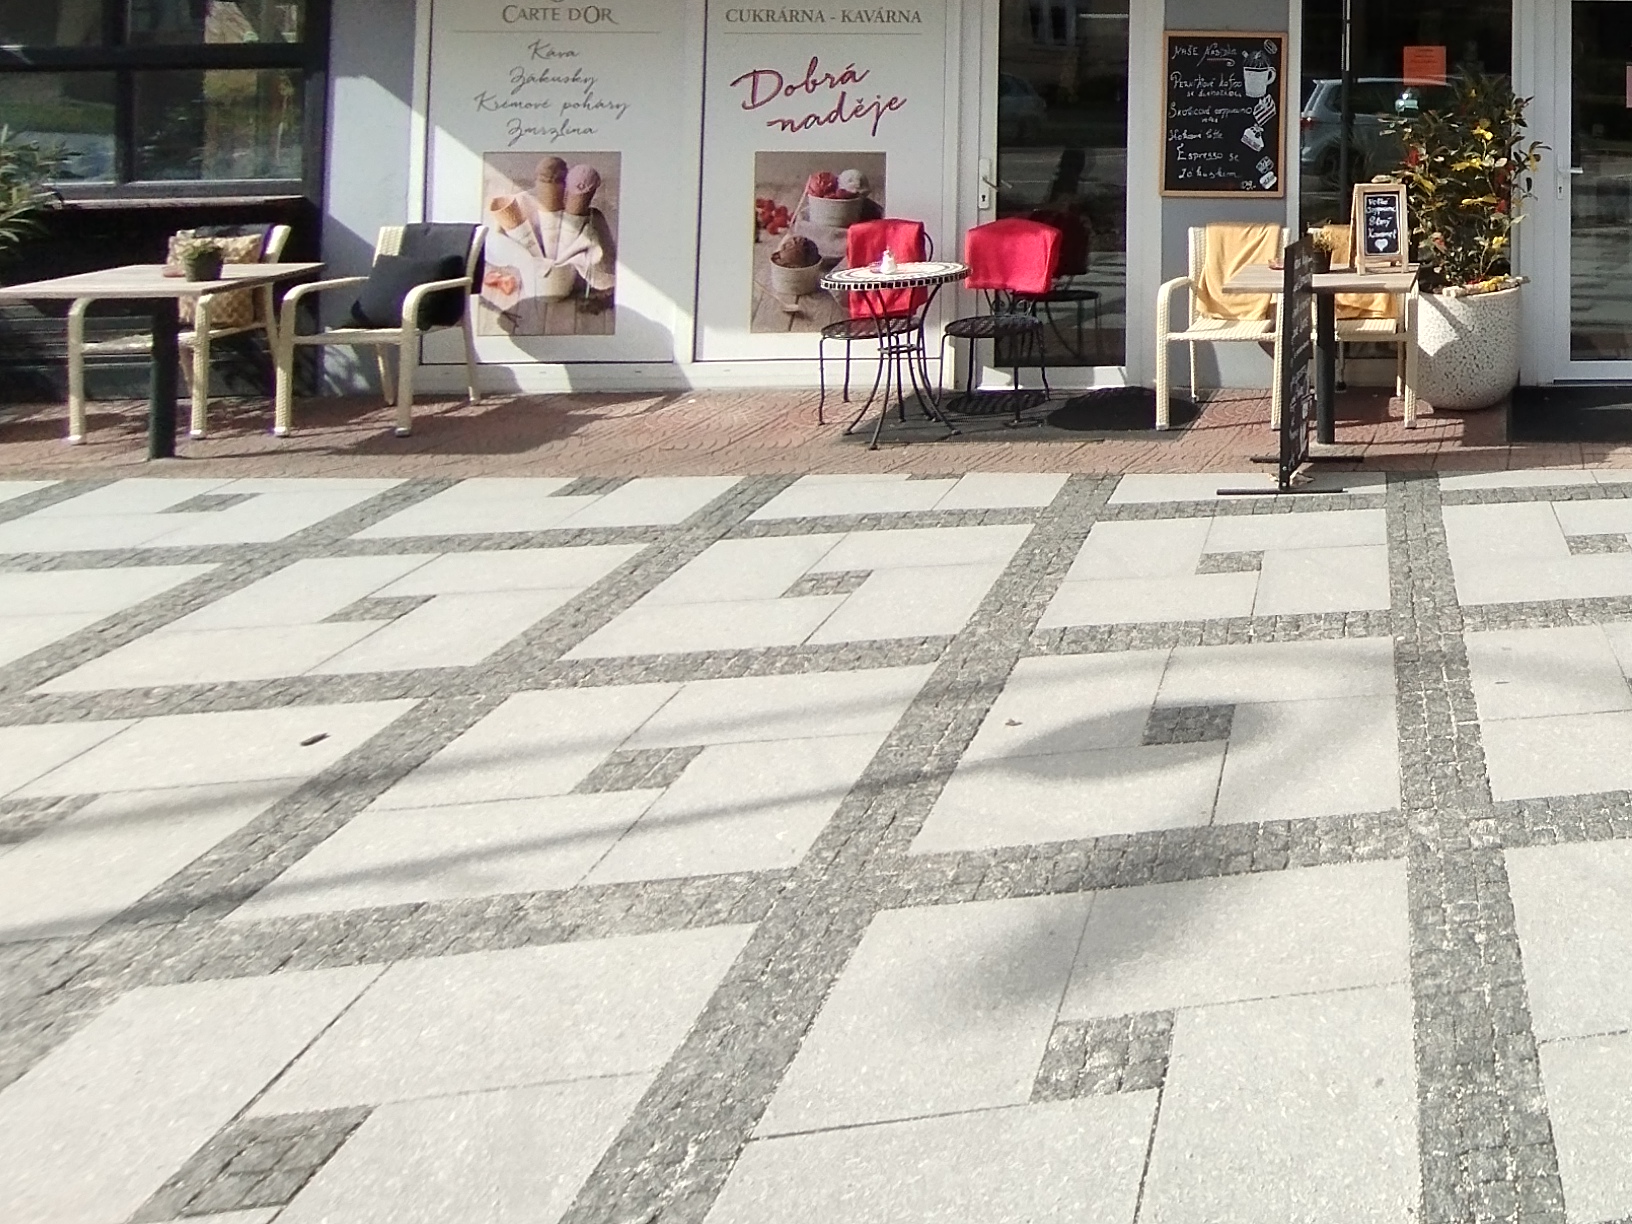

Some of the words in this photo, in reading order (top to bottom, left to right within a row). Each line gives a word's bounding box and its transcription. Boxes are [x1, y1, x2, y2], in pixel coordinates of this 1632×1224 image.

[502, 4, 562, 24] CARTE
[725, 7, 826, 23] CUKRÁRNA
[840, 7, 922, 24] KAVÁRNA
[729, 56, 870, 110] Dobrá
[766, 91, 908, 137] naděje
[506, 117, 600, 148] Zmrzlina
